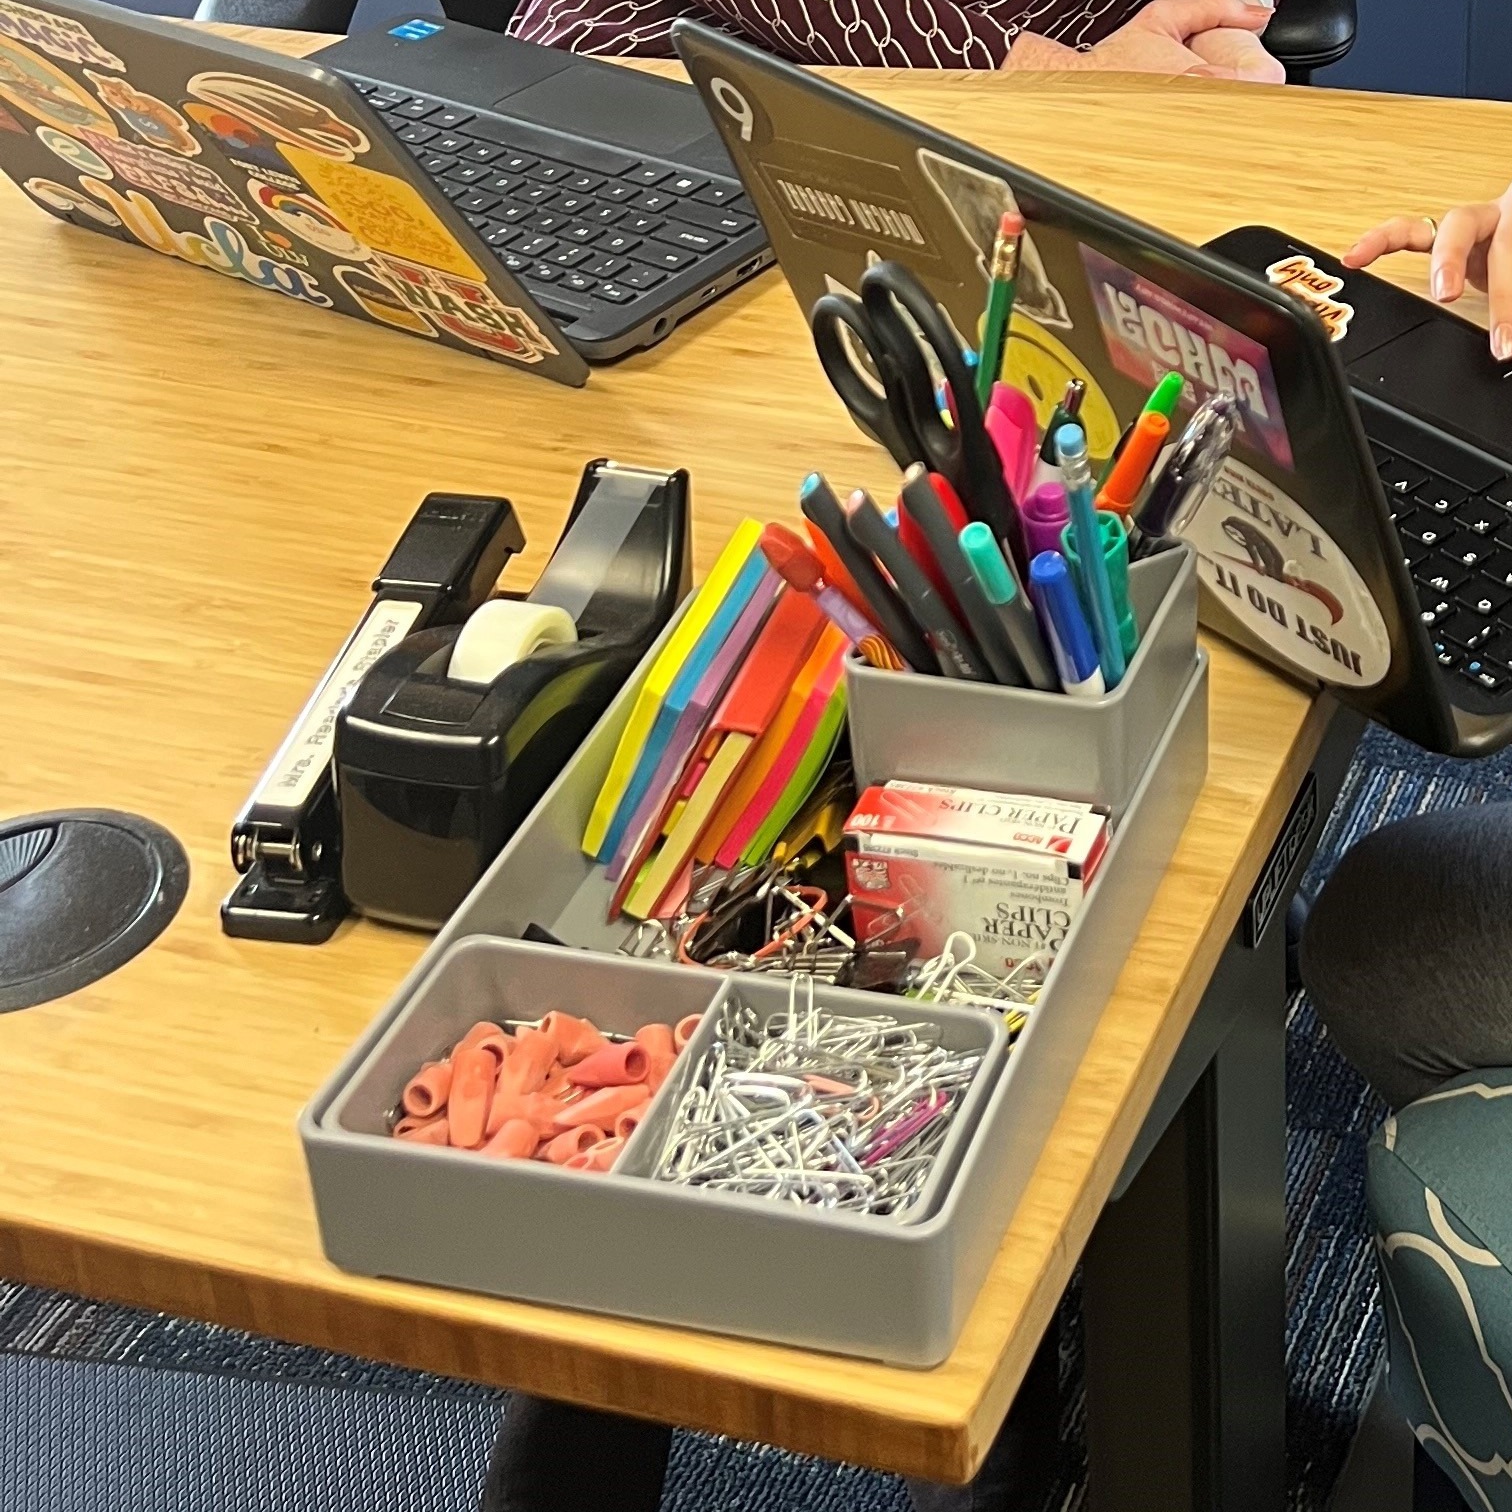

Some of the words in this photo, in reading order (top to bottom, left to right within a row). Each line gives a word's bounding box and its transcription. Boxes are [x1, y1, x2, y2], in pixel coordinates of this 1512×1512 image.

[393, 275, 540, 346] WASH
[1247, 584, 1288, 629] DO
[1296, 614, 1363, 678] JUST
[850, 812, 881, 828] 100
[937, 798, 1001, 816] CLIPS
[1008, 806, 1082, 835] PAPER
[996, 902, 1071, 928] CLIPS
[981, 917, 1069, 952] PAPER
